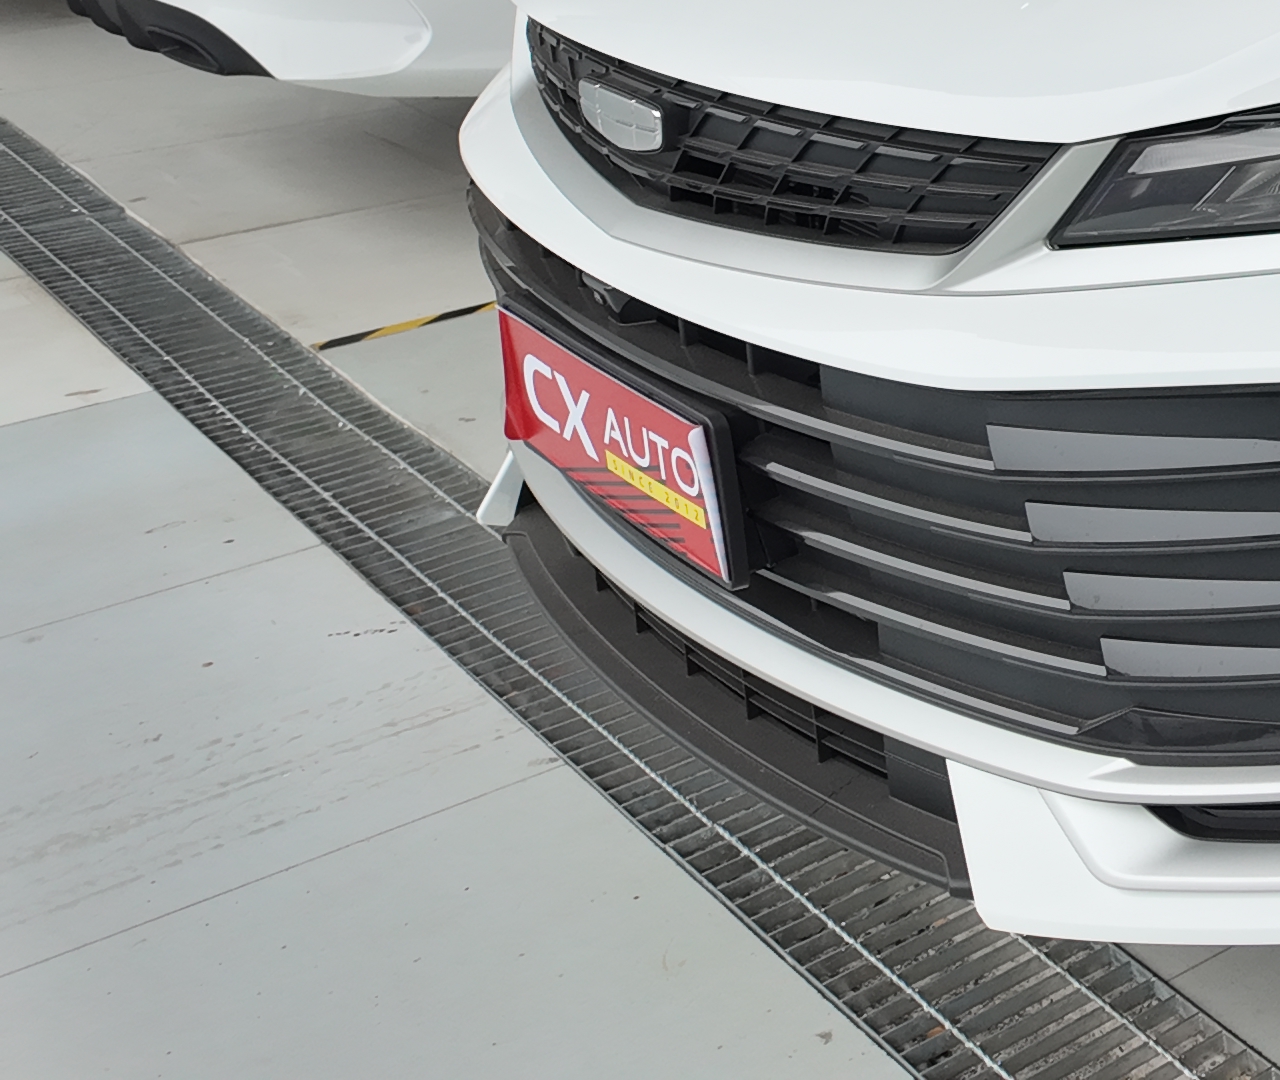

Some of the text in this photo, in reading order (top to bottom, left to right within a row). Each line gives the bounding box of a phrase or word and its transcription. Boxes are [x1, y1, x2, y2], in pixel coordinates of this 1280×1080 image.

[523, 353, 701, 497] CX AUTO
[612, 458, 701, 521] SINCE 2012
